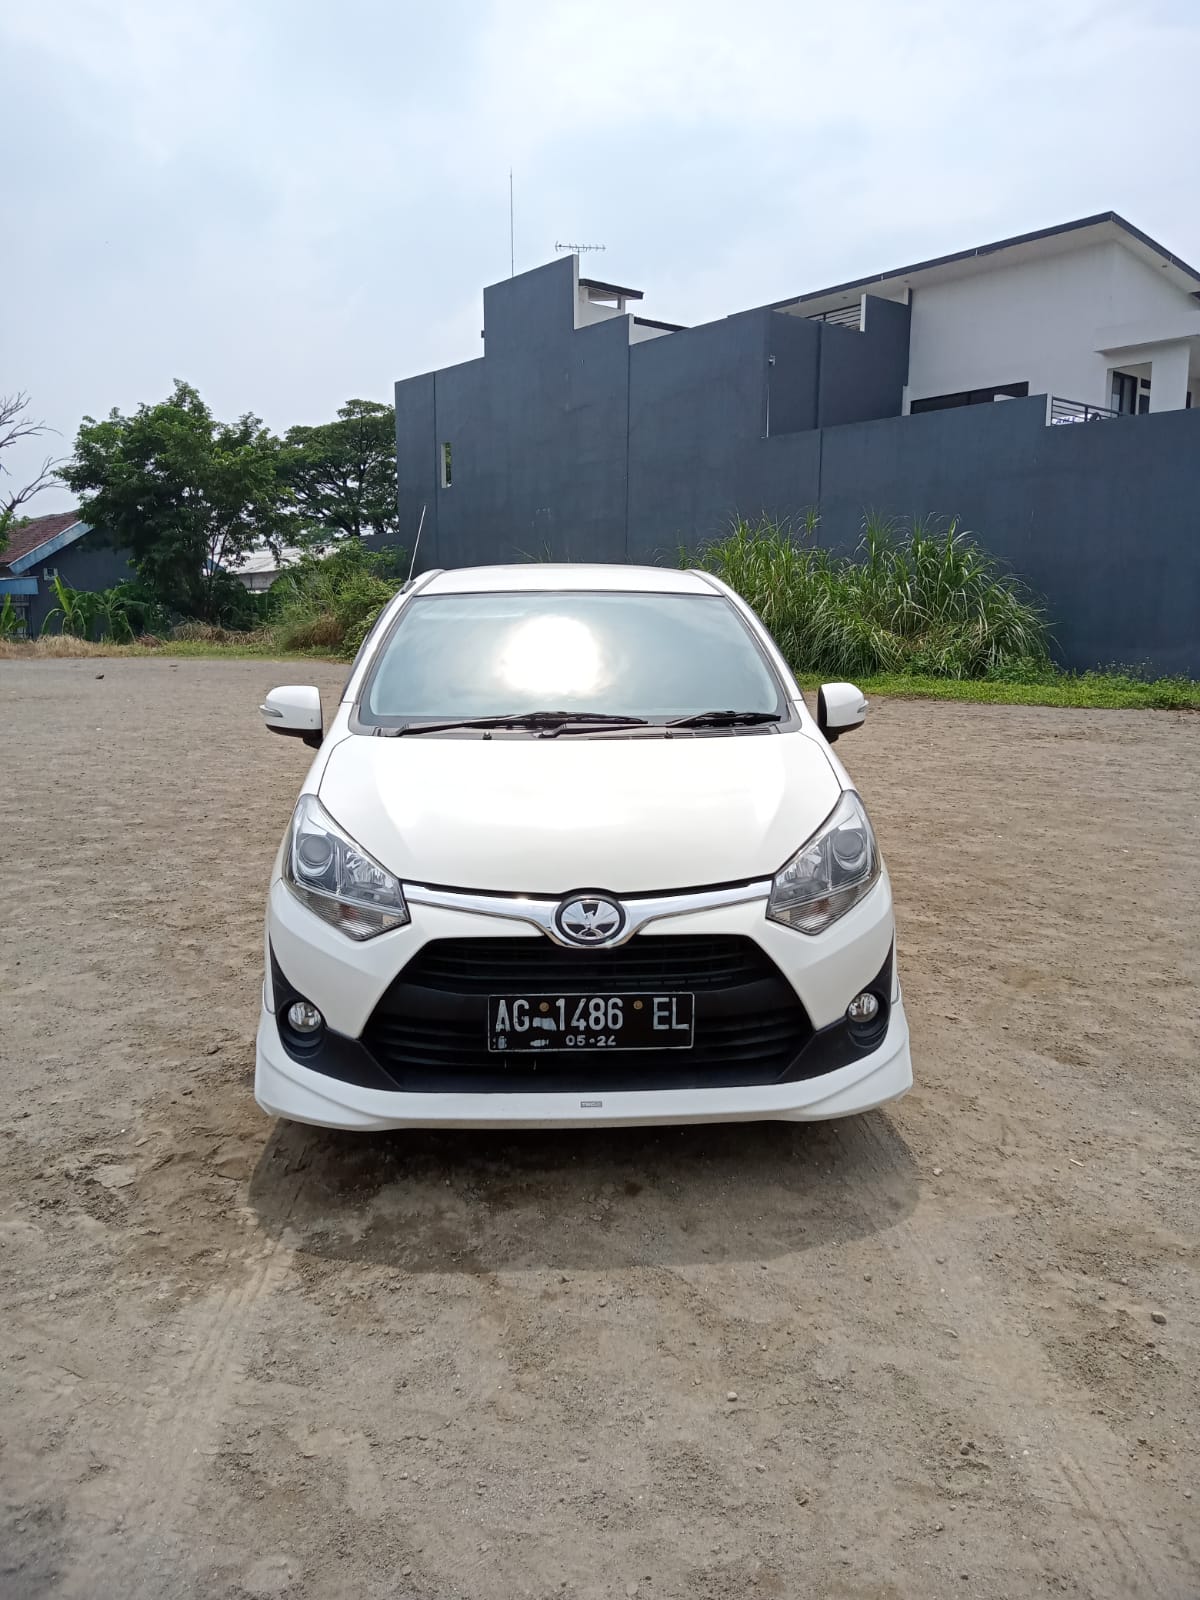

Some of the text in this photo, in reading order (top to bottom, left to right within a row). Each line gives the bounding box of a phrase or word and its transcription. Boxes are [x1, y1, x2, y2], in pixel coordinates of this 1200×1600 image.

[495, 997, 690, 1032] AG 1486 EL
